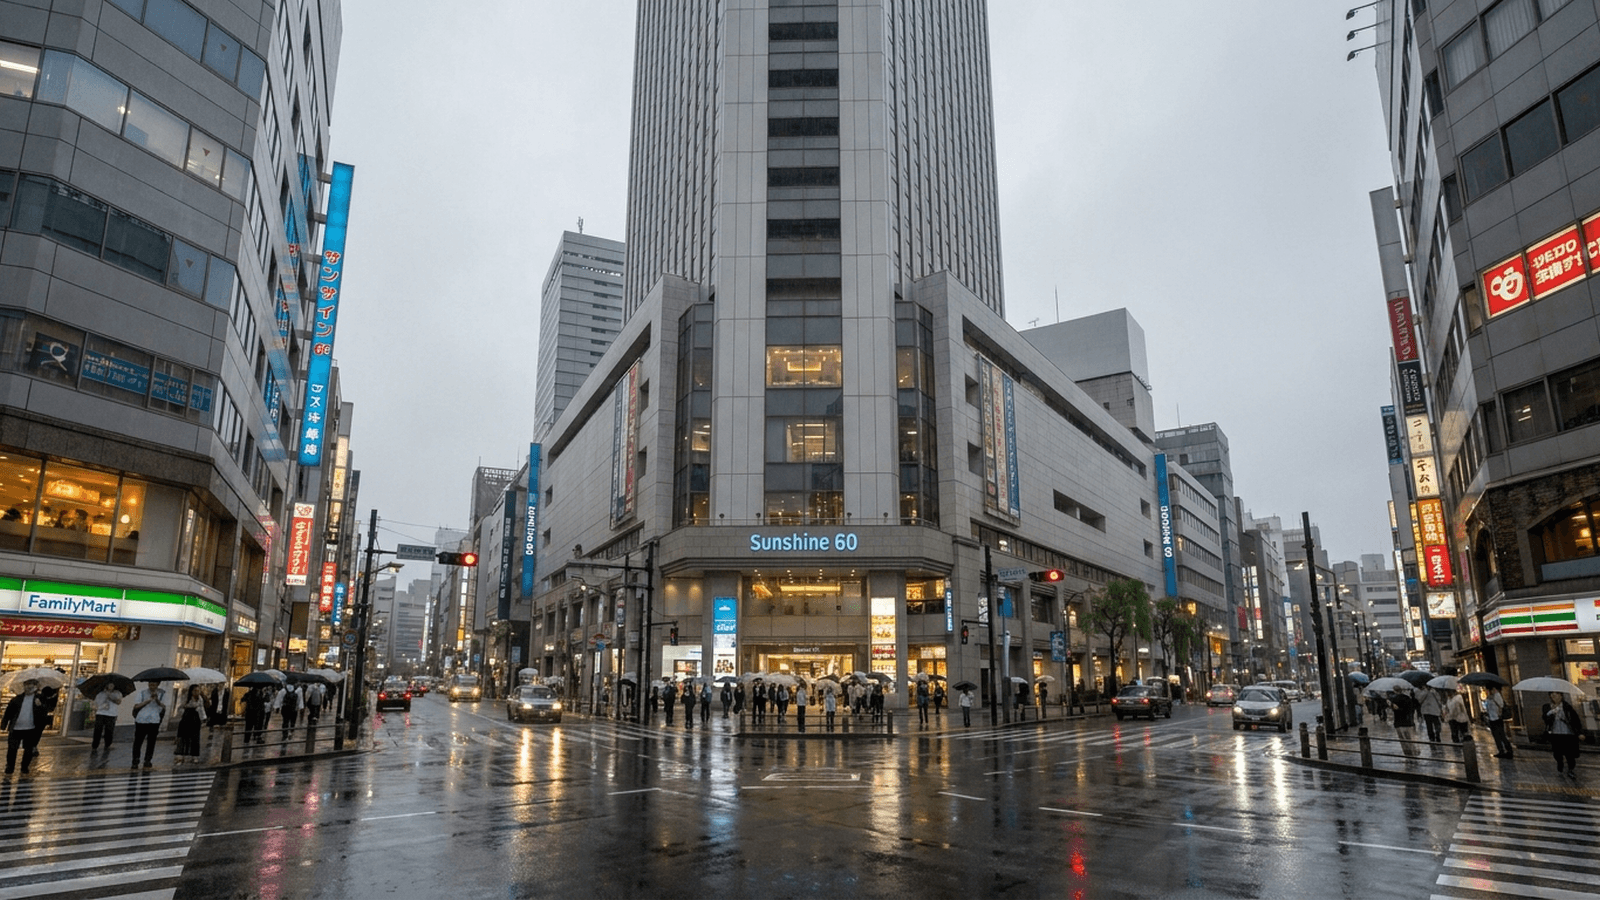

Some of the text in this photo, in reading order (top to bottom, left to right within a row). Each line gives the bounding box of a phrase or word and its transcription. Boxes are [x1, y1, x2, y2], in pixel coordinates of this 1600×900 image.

[750, 532, 858, 551] Sunshine 60
[28, 594, 117, 613] FamilyMart
